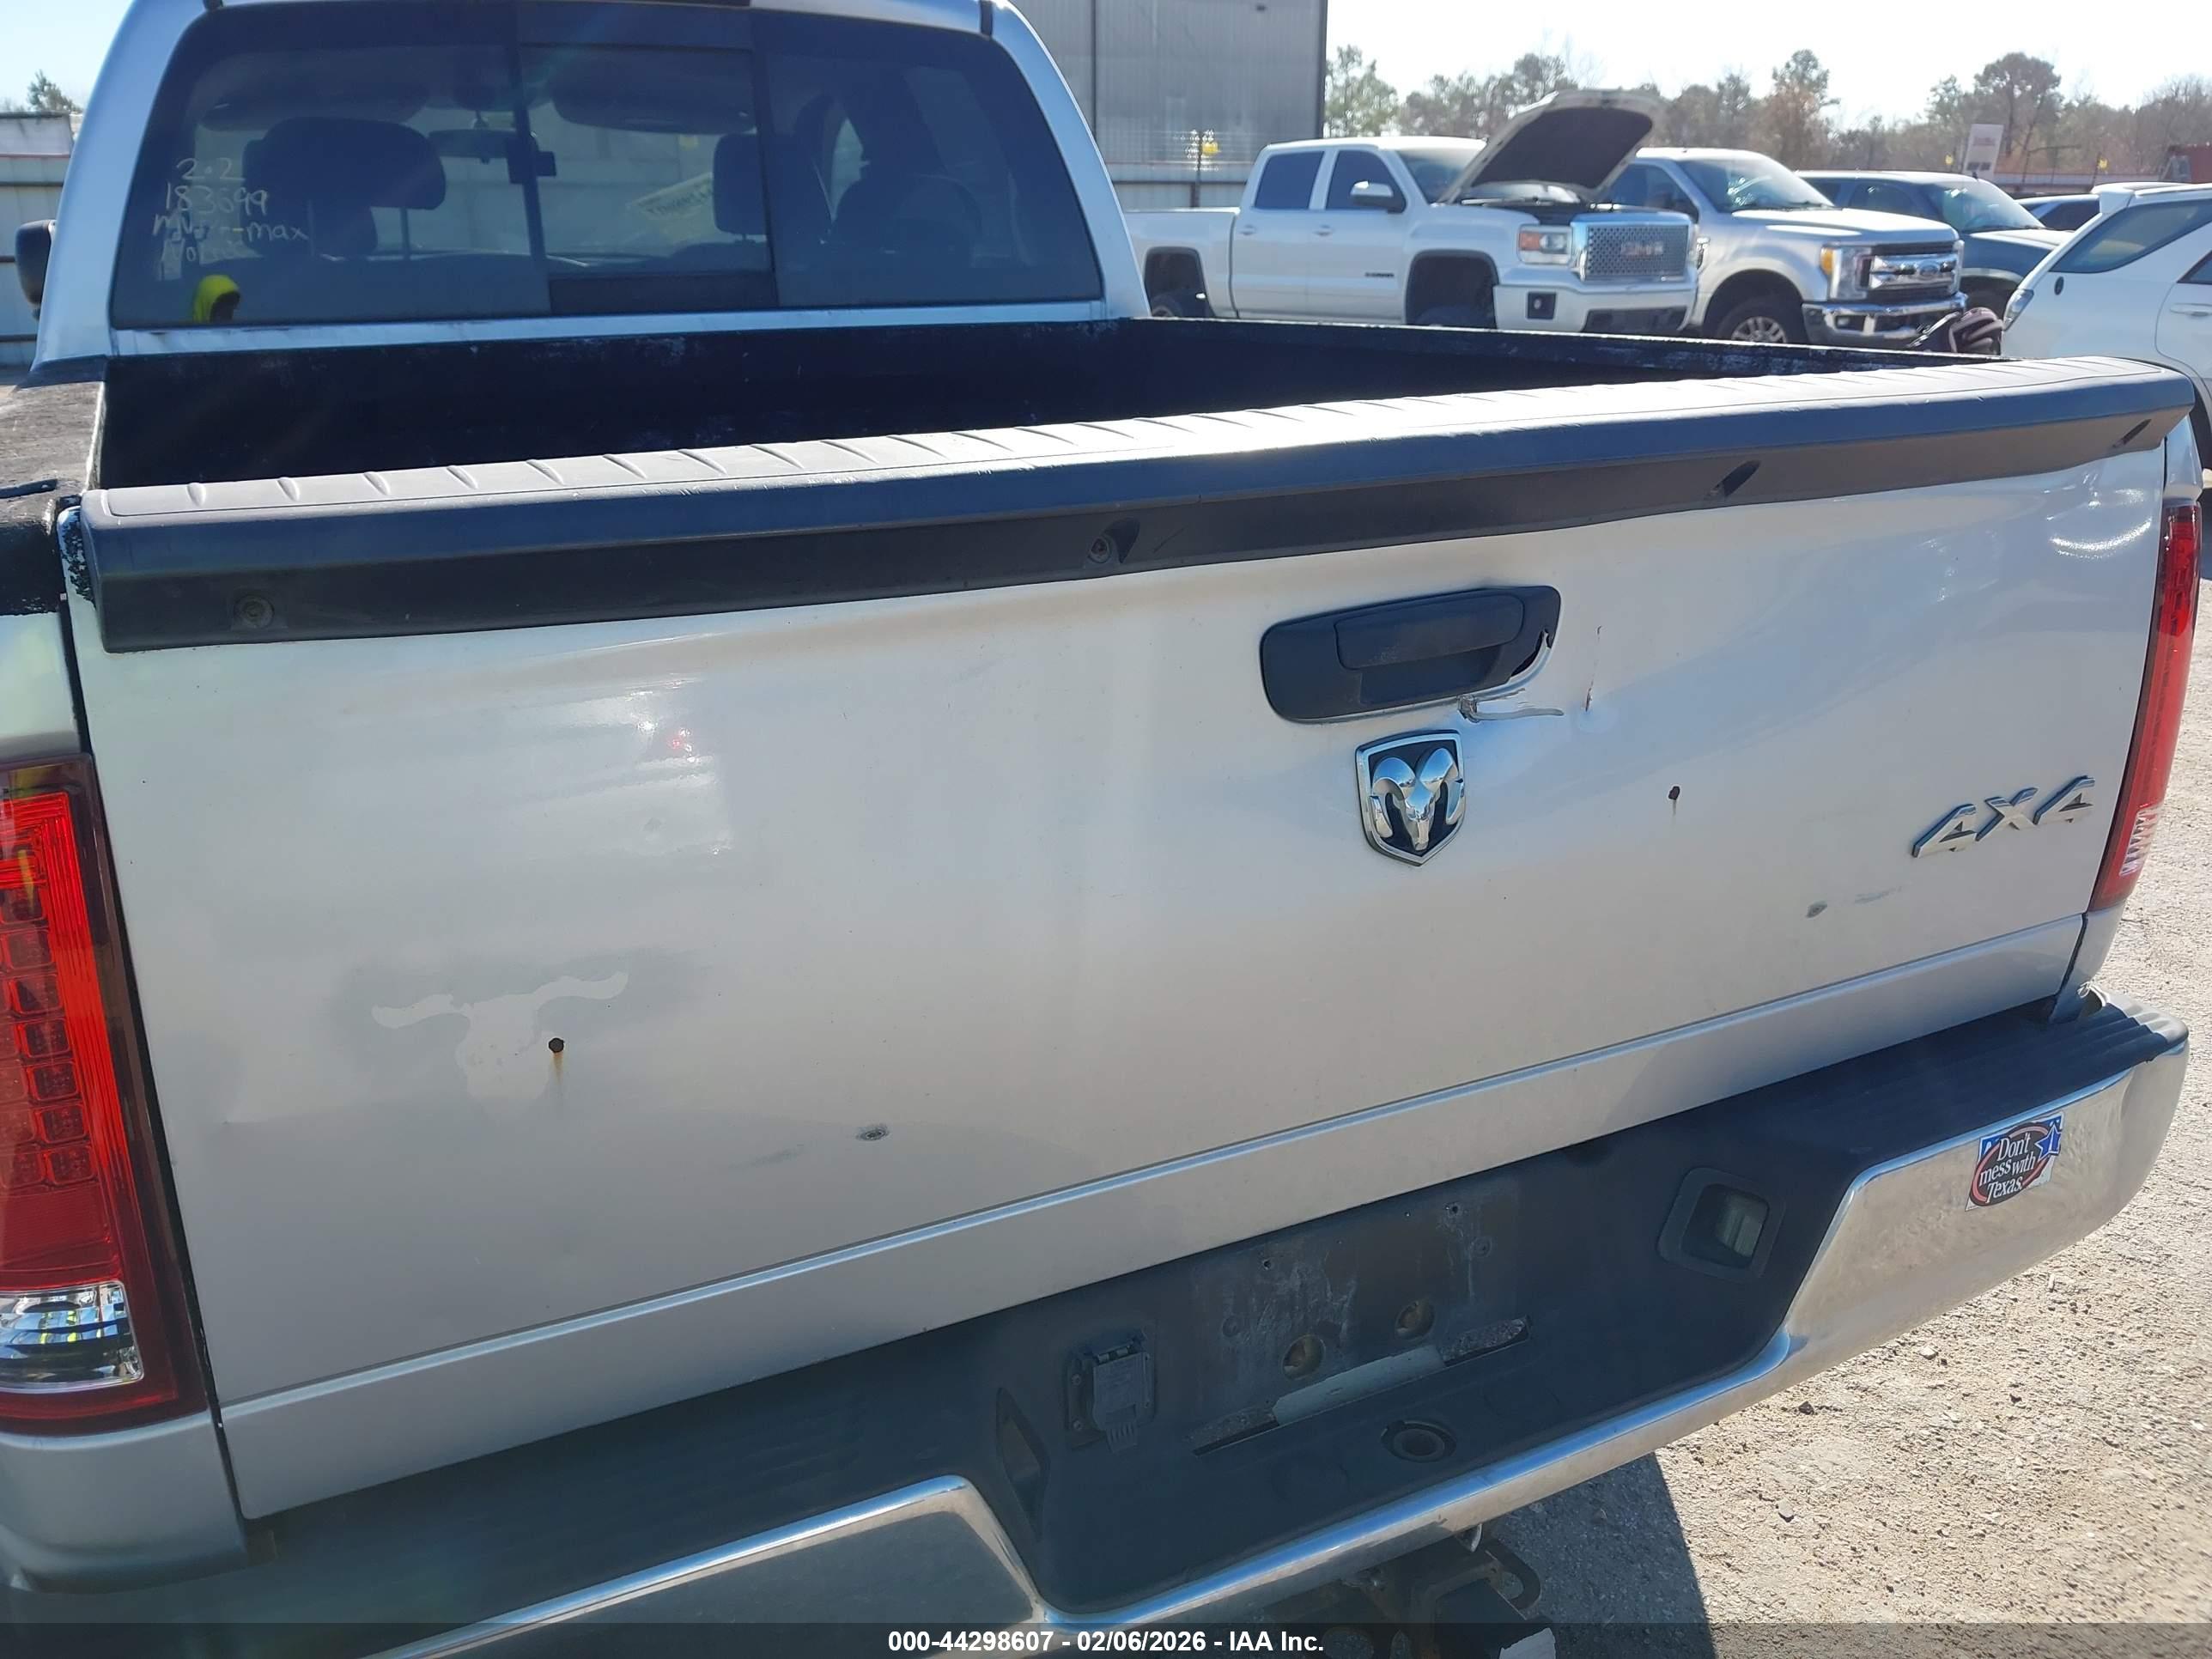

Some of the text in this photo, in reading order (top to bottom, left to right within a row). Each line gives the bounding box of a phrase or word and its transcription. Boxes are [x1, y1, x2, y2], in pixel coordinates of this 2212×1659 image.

[1996, 1133, 2031, 1162] Don't
[1978, 1151, 2037, 1187] mess with
